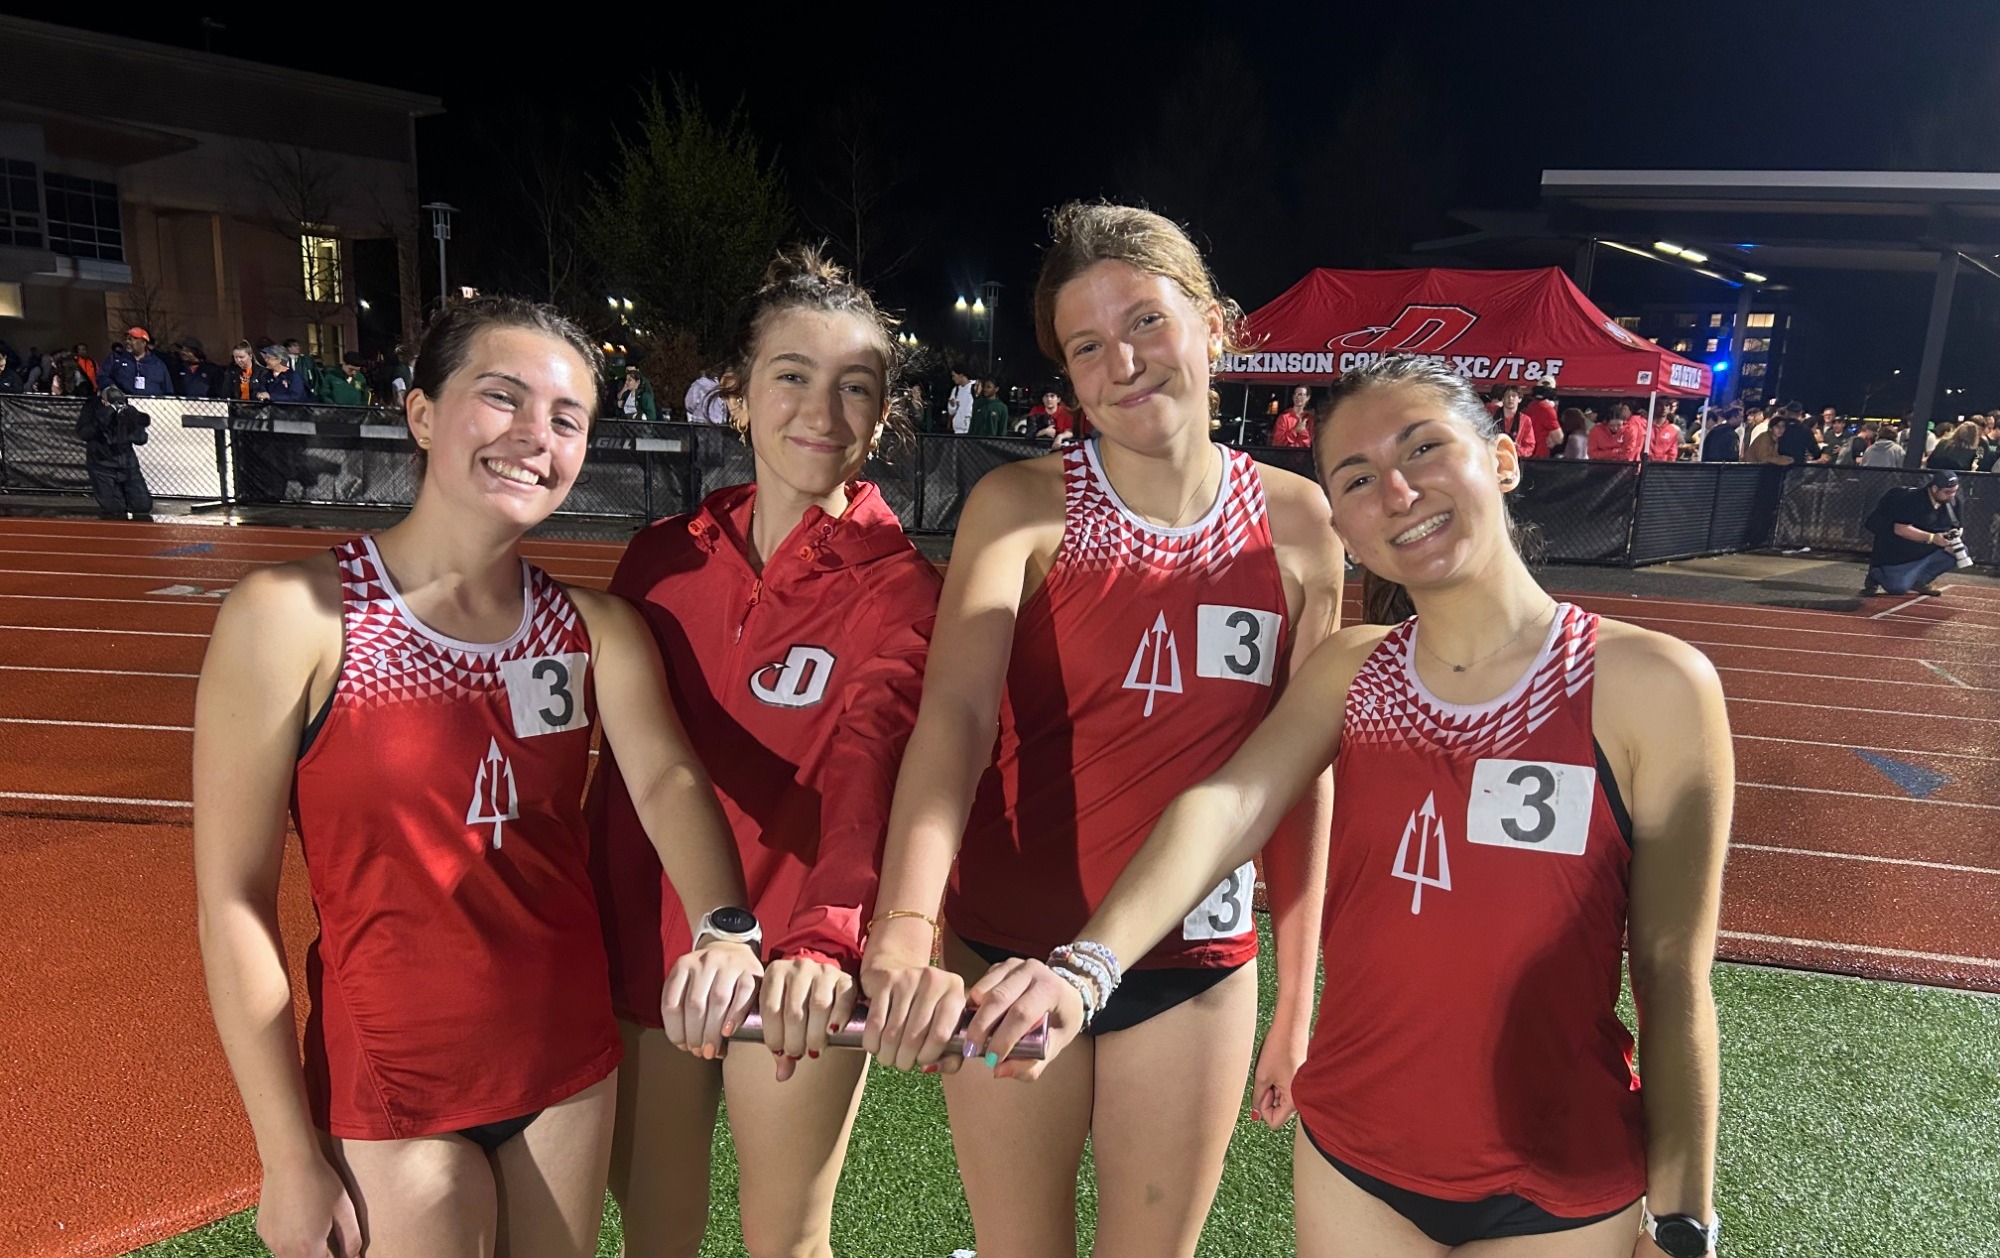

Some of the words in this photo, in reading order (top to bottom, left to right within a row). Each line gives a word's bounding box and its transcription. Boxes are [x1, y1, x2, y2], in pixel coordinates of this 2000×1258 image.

[1450, 355, 1563, 380] XC/T&F
[233, 419, 270, 432] GILL
[595, 437, 632, 450] GILL
[1224, 610, 1261, 676] 3
[532, 659, 574, 727] 3
[1500, 765, 1556, 843] 3
[1208, 868, 1242, 932] 3
